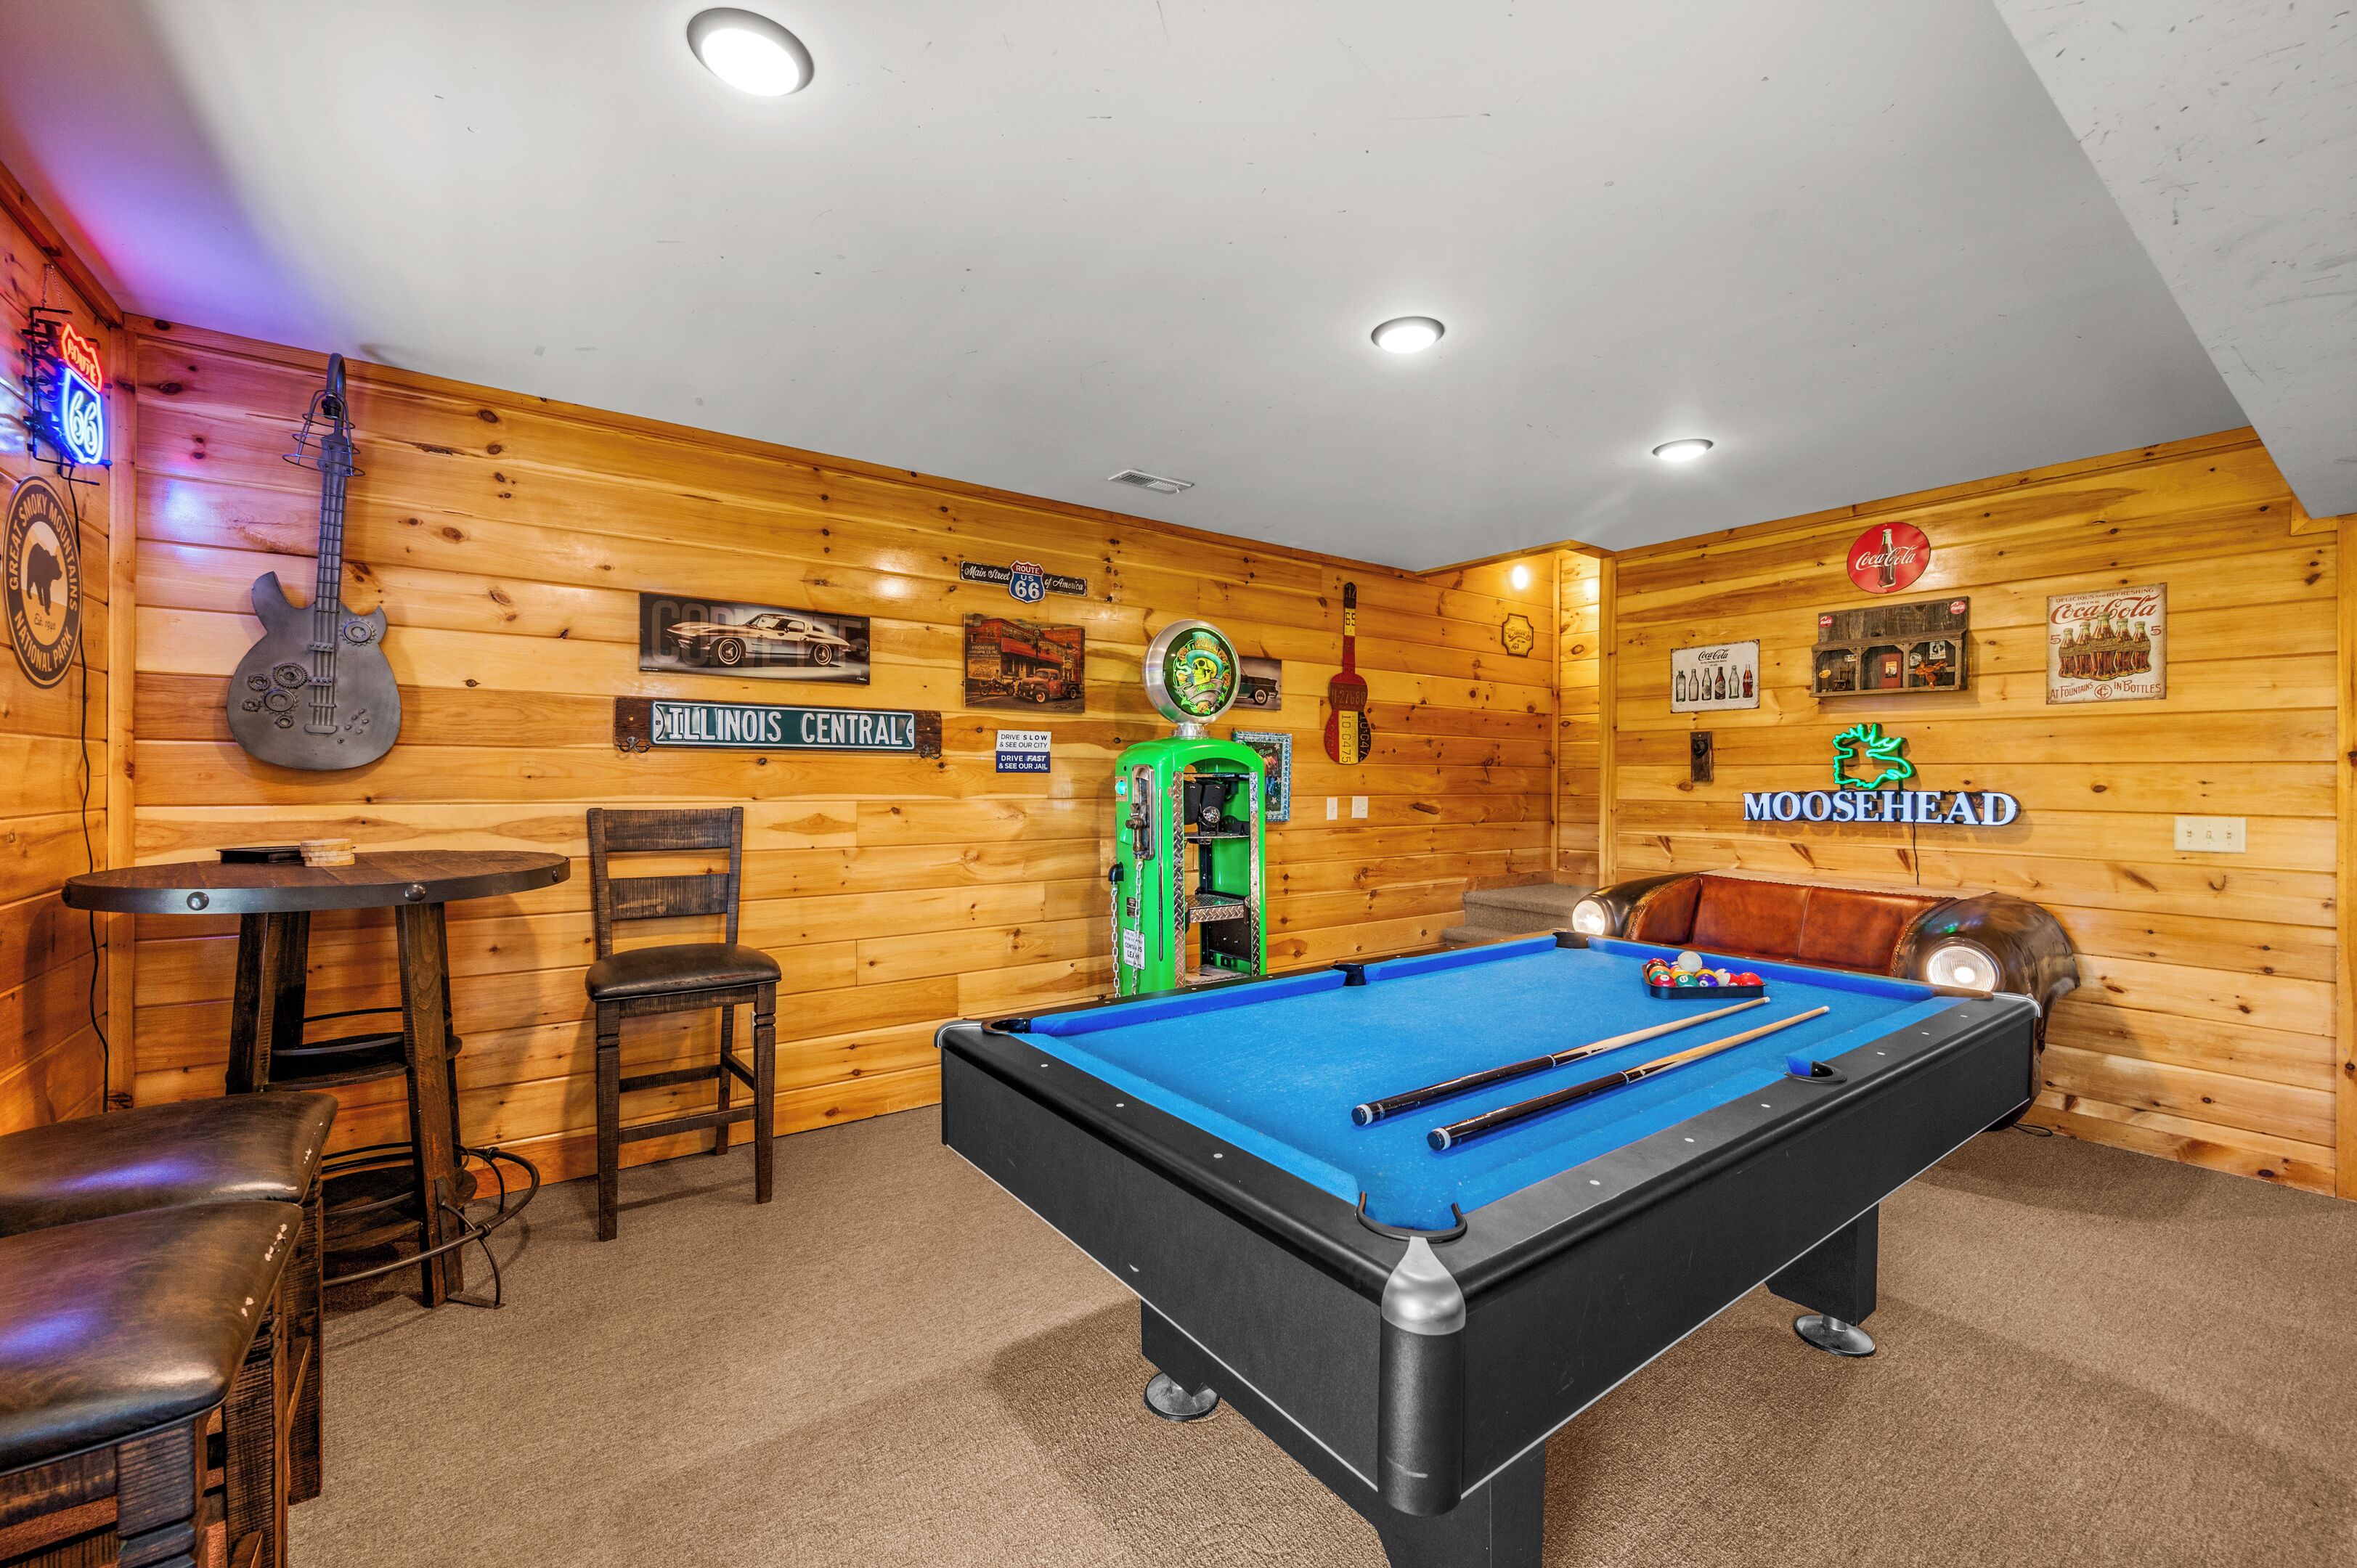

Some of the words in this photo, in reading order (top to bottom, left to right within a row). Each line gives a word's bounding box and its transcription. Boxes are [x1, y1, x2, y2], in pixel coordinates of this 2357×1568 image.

[68, 338, 97, 383] ROUTE
[70, 391, 97, 455] 66
[9, 520, 24, 590] GREAT
[19, 493, 48, 527] SMOKY
[49, 502, 78, 612] MOUNTAINS
[1855, 545, 1918, 571] Coca-Cola
[964, 566, 986, 579] Main
[988, 570, 1011, 581] Street
[1016, 565, 1040, 574] ROUTE
[1014, 580, 1040, 600] 66
[1044, 579, 1051, 589] of
[1053, 580, 1084, 591] America
[2056, 595, 2095, 603] DELICIOUS
[2106, 587, 2154, 597] REFRESHING
[2051, 595, 2160, 625] Coca-Cola
[15, 610, 52, 673] NATIONAL
[53, 626, 73, 669] PARK
[2050, 689, 2059, 699] AT
[2059, 682, 2093, 698] FOUNTAINS
[2114, 682, 2122, 690] IN
[2122, 679, 2162, 693] BOTTLES
[669, 706, 782, 743] ILLINOIS
[801, 712, 903, 746] CENTRAL
[1743, 791, 2017, 826] MOOSEHEAD
